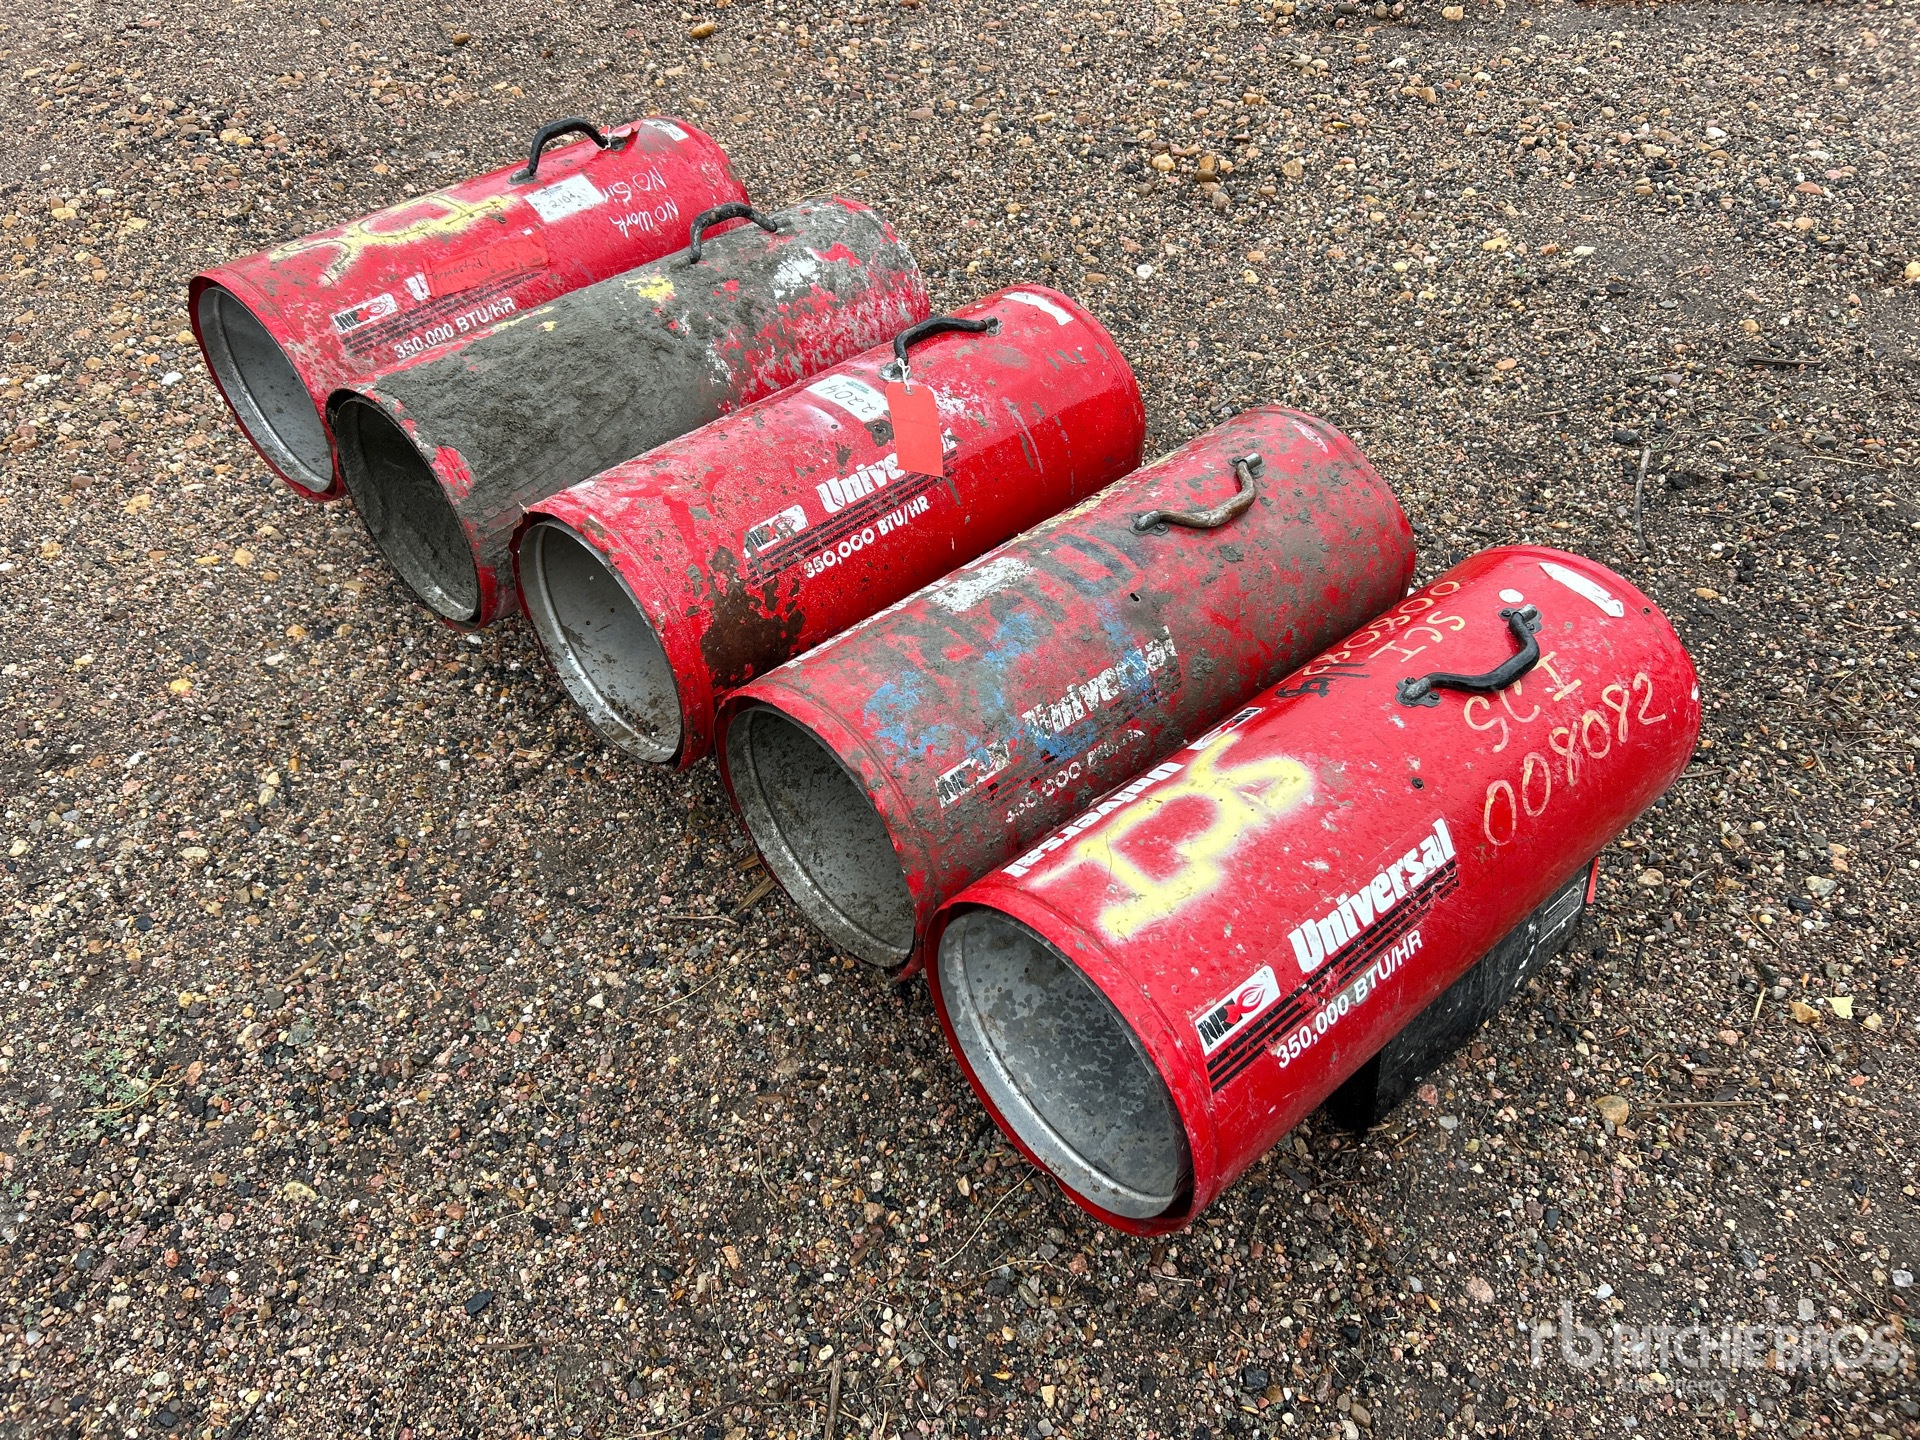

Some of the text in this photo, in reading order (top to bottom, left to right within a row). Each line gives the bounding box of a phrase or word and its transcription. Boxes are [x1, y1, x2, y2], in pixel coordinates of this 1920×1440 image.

[655, 197, 679, 222] NO
[394, 296, 516, 360] 350,000 BTU/HR
[820, 384, 877, 414] 2204
[815, 427, 958, 514] Univel
[803, 529, 875, 579] 350,000
[877, 495, 930, 536] BTU/HR
[1463, 651, 1582, 753] SCI
[1484, 672, 1667, 846] 008082
[1001, 761, 1186, 878] Universal
[1287, 818, 1457, 974] Universal
[1276, 929, 1423, 1069] 350,000 BTU/HR
